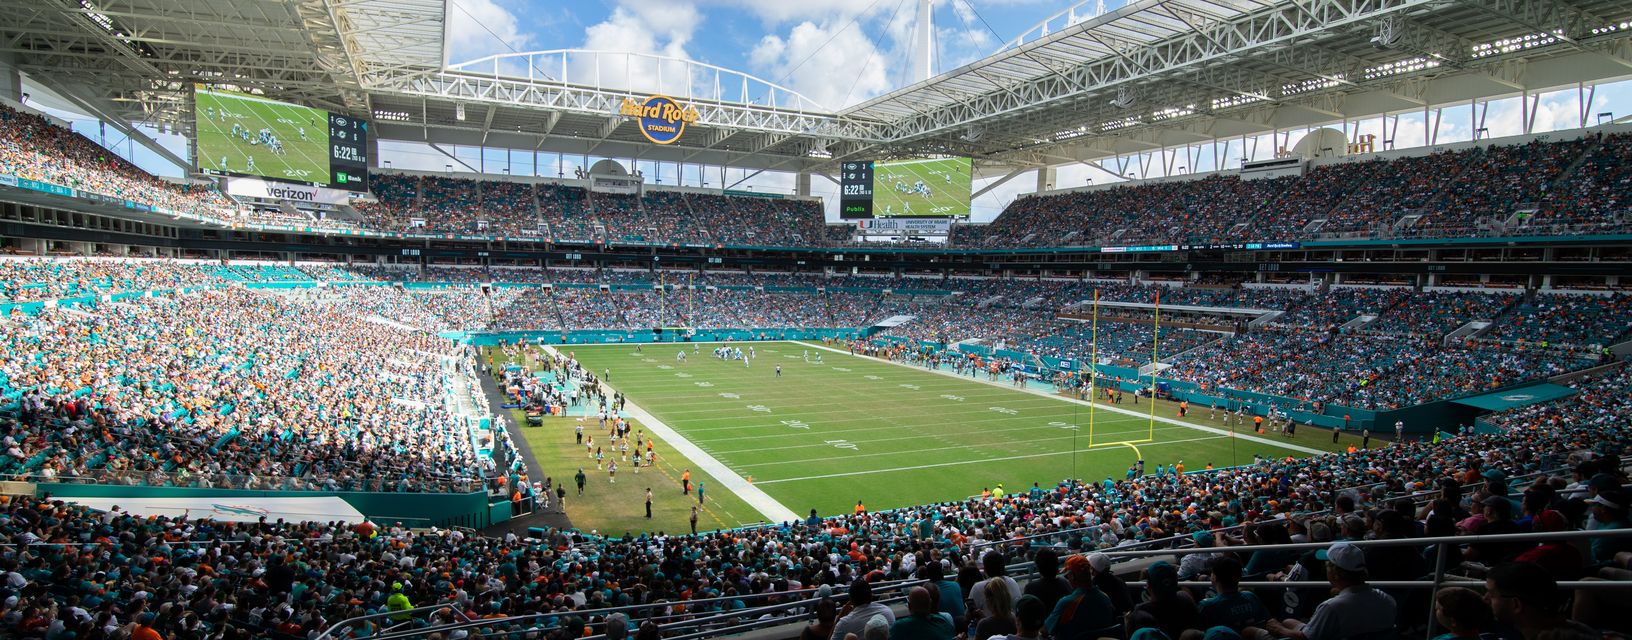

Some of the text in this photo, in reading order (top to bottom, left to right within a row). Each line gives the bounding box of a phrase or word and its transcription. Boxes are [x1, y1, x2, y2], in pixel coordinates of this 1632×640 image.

[619, 98, 698, 125] Hard Rock
[647, 124, 675, 133] STADIUM
[333, 144, 351, 160] 6:22
[266, 186, 313, 201] verizon
[844, 184, 859, 195] 6:22
